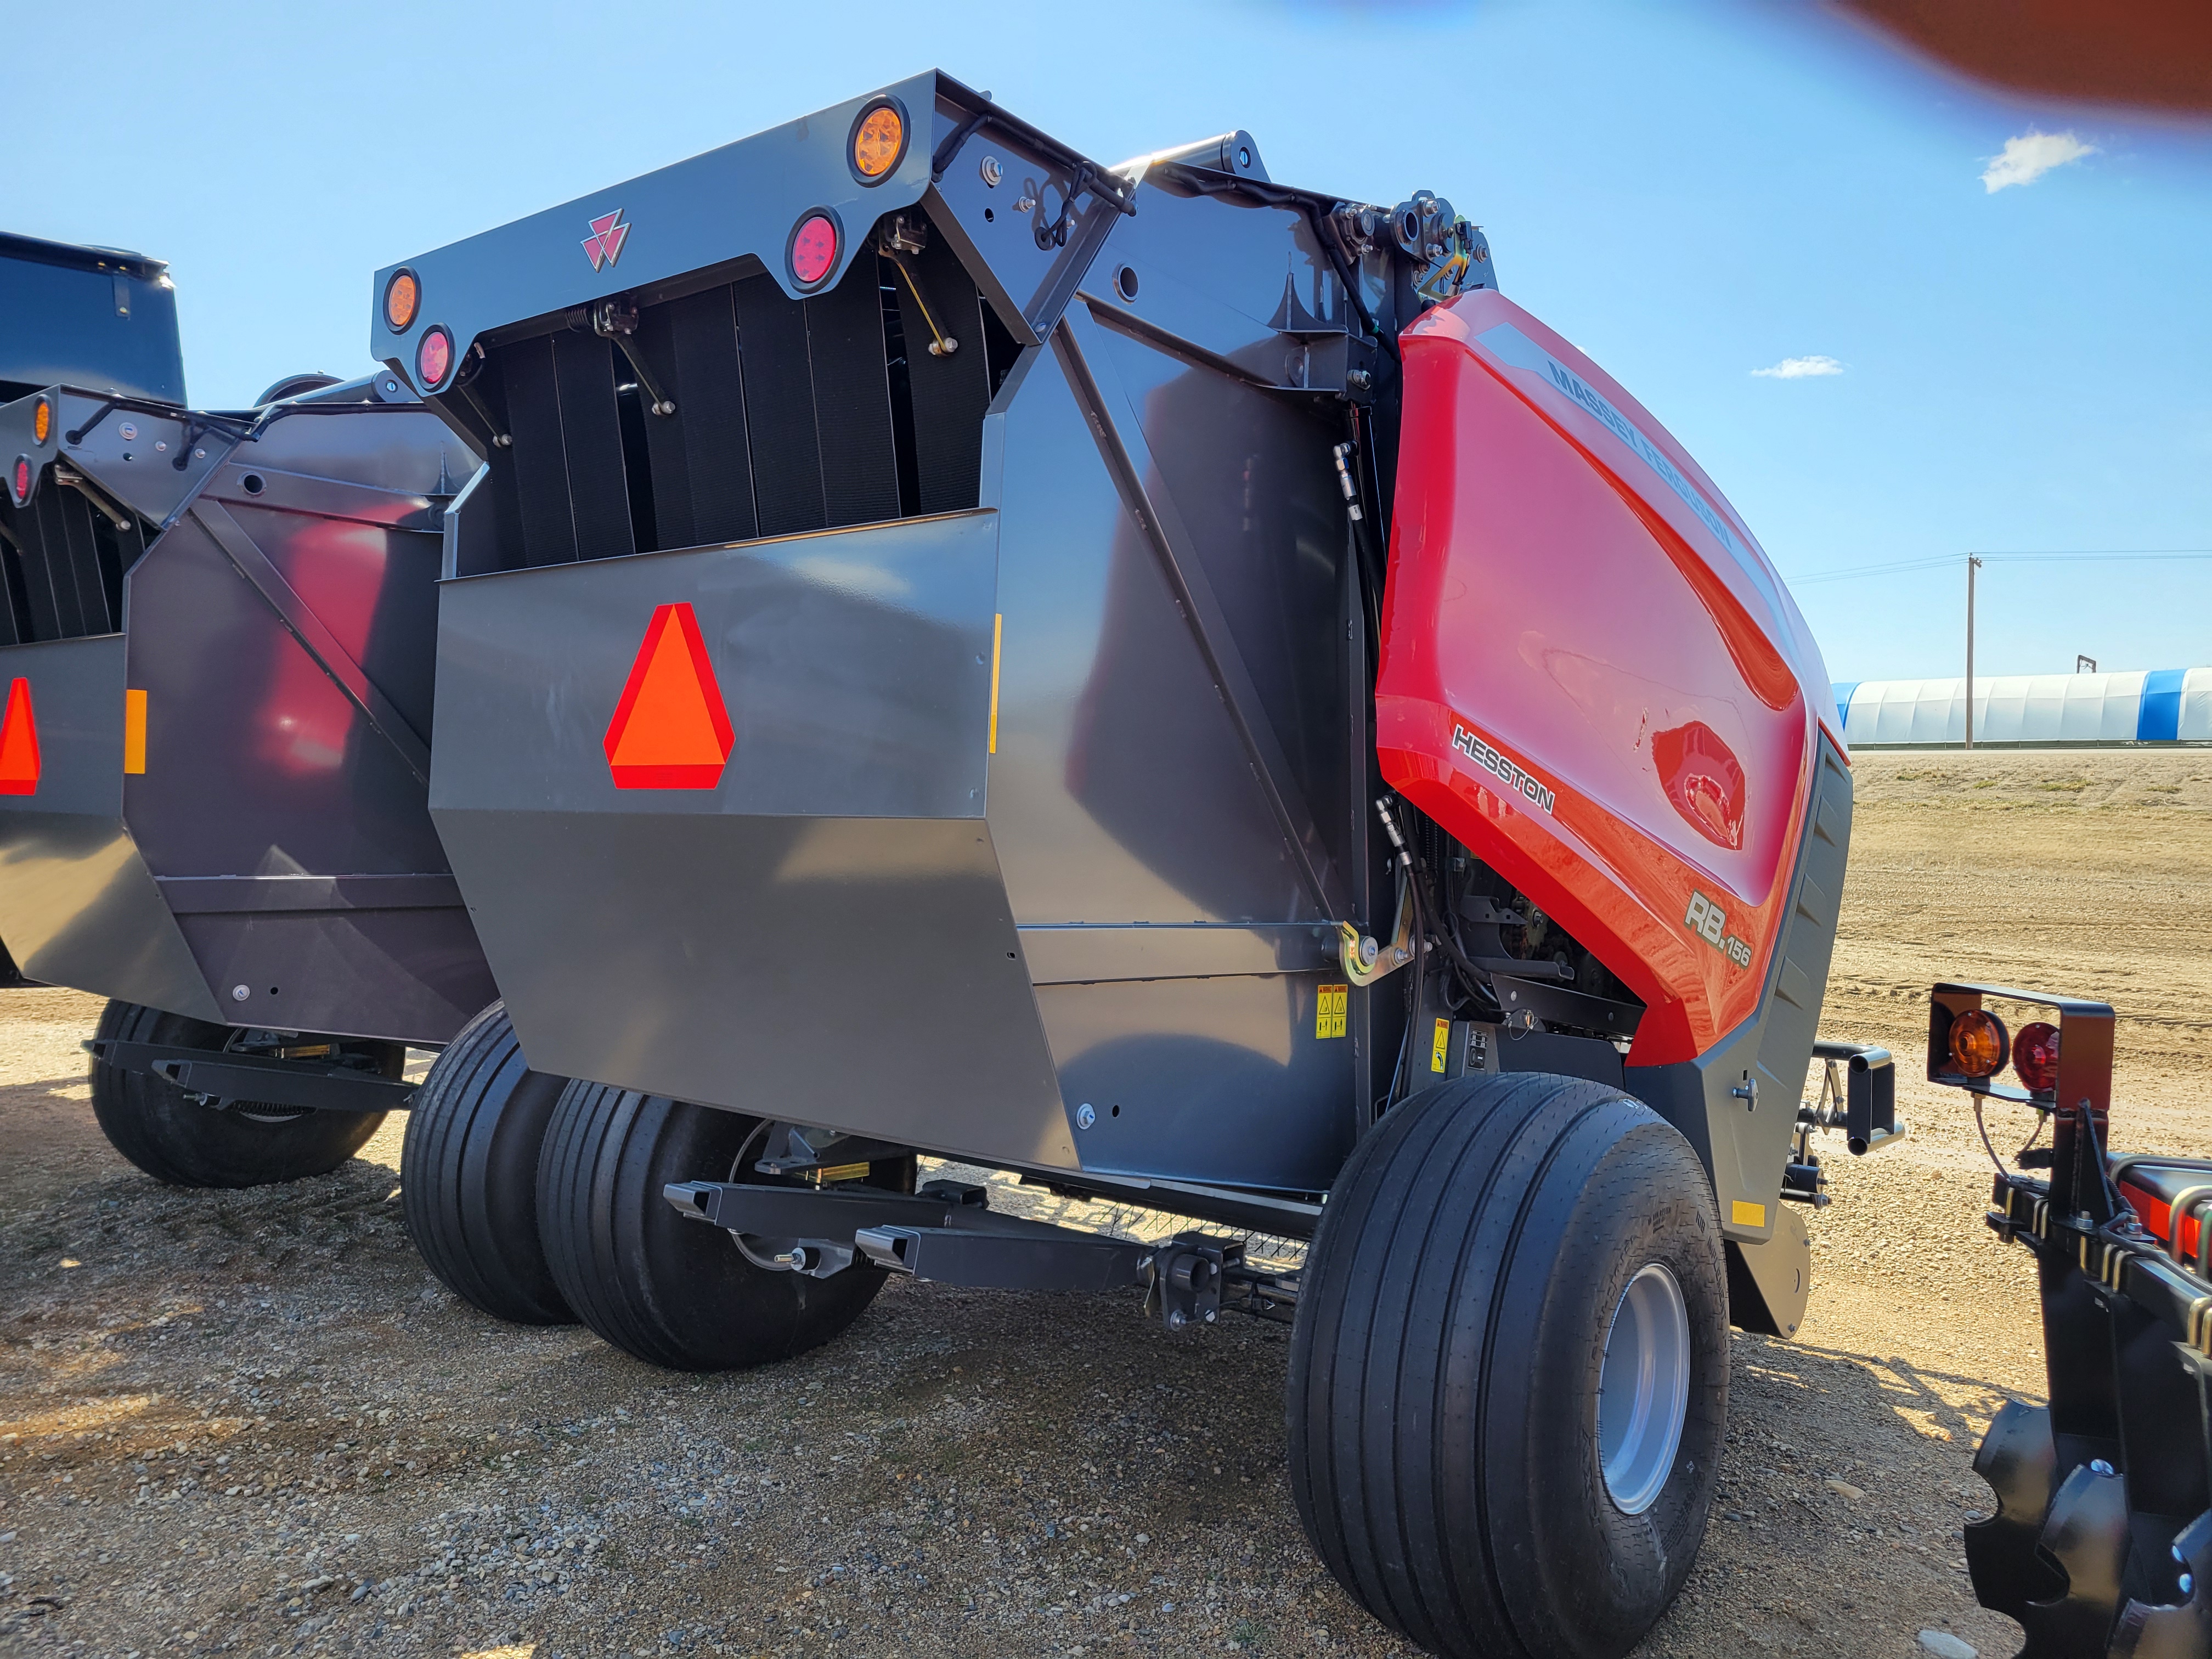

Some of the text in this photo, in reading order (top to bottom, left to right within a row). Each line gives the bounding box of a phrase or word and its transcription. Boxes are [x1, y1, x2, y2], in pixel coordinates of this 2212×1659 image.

[1547, 360, 1732, 549] MASSEY FERGUSON
[1453, 724, 1555, 814] HESSTON
